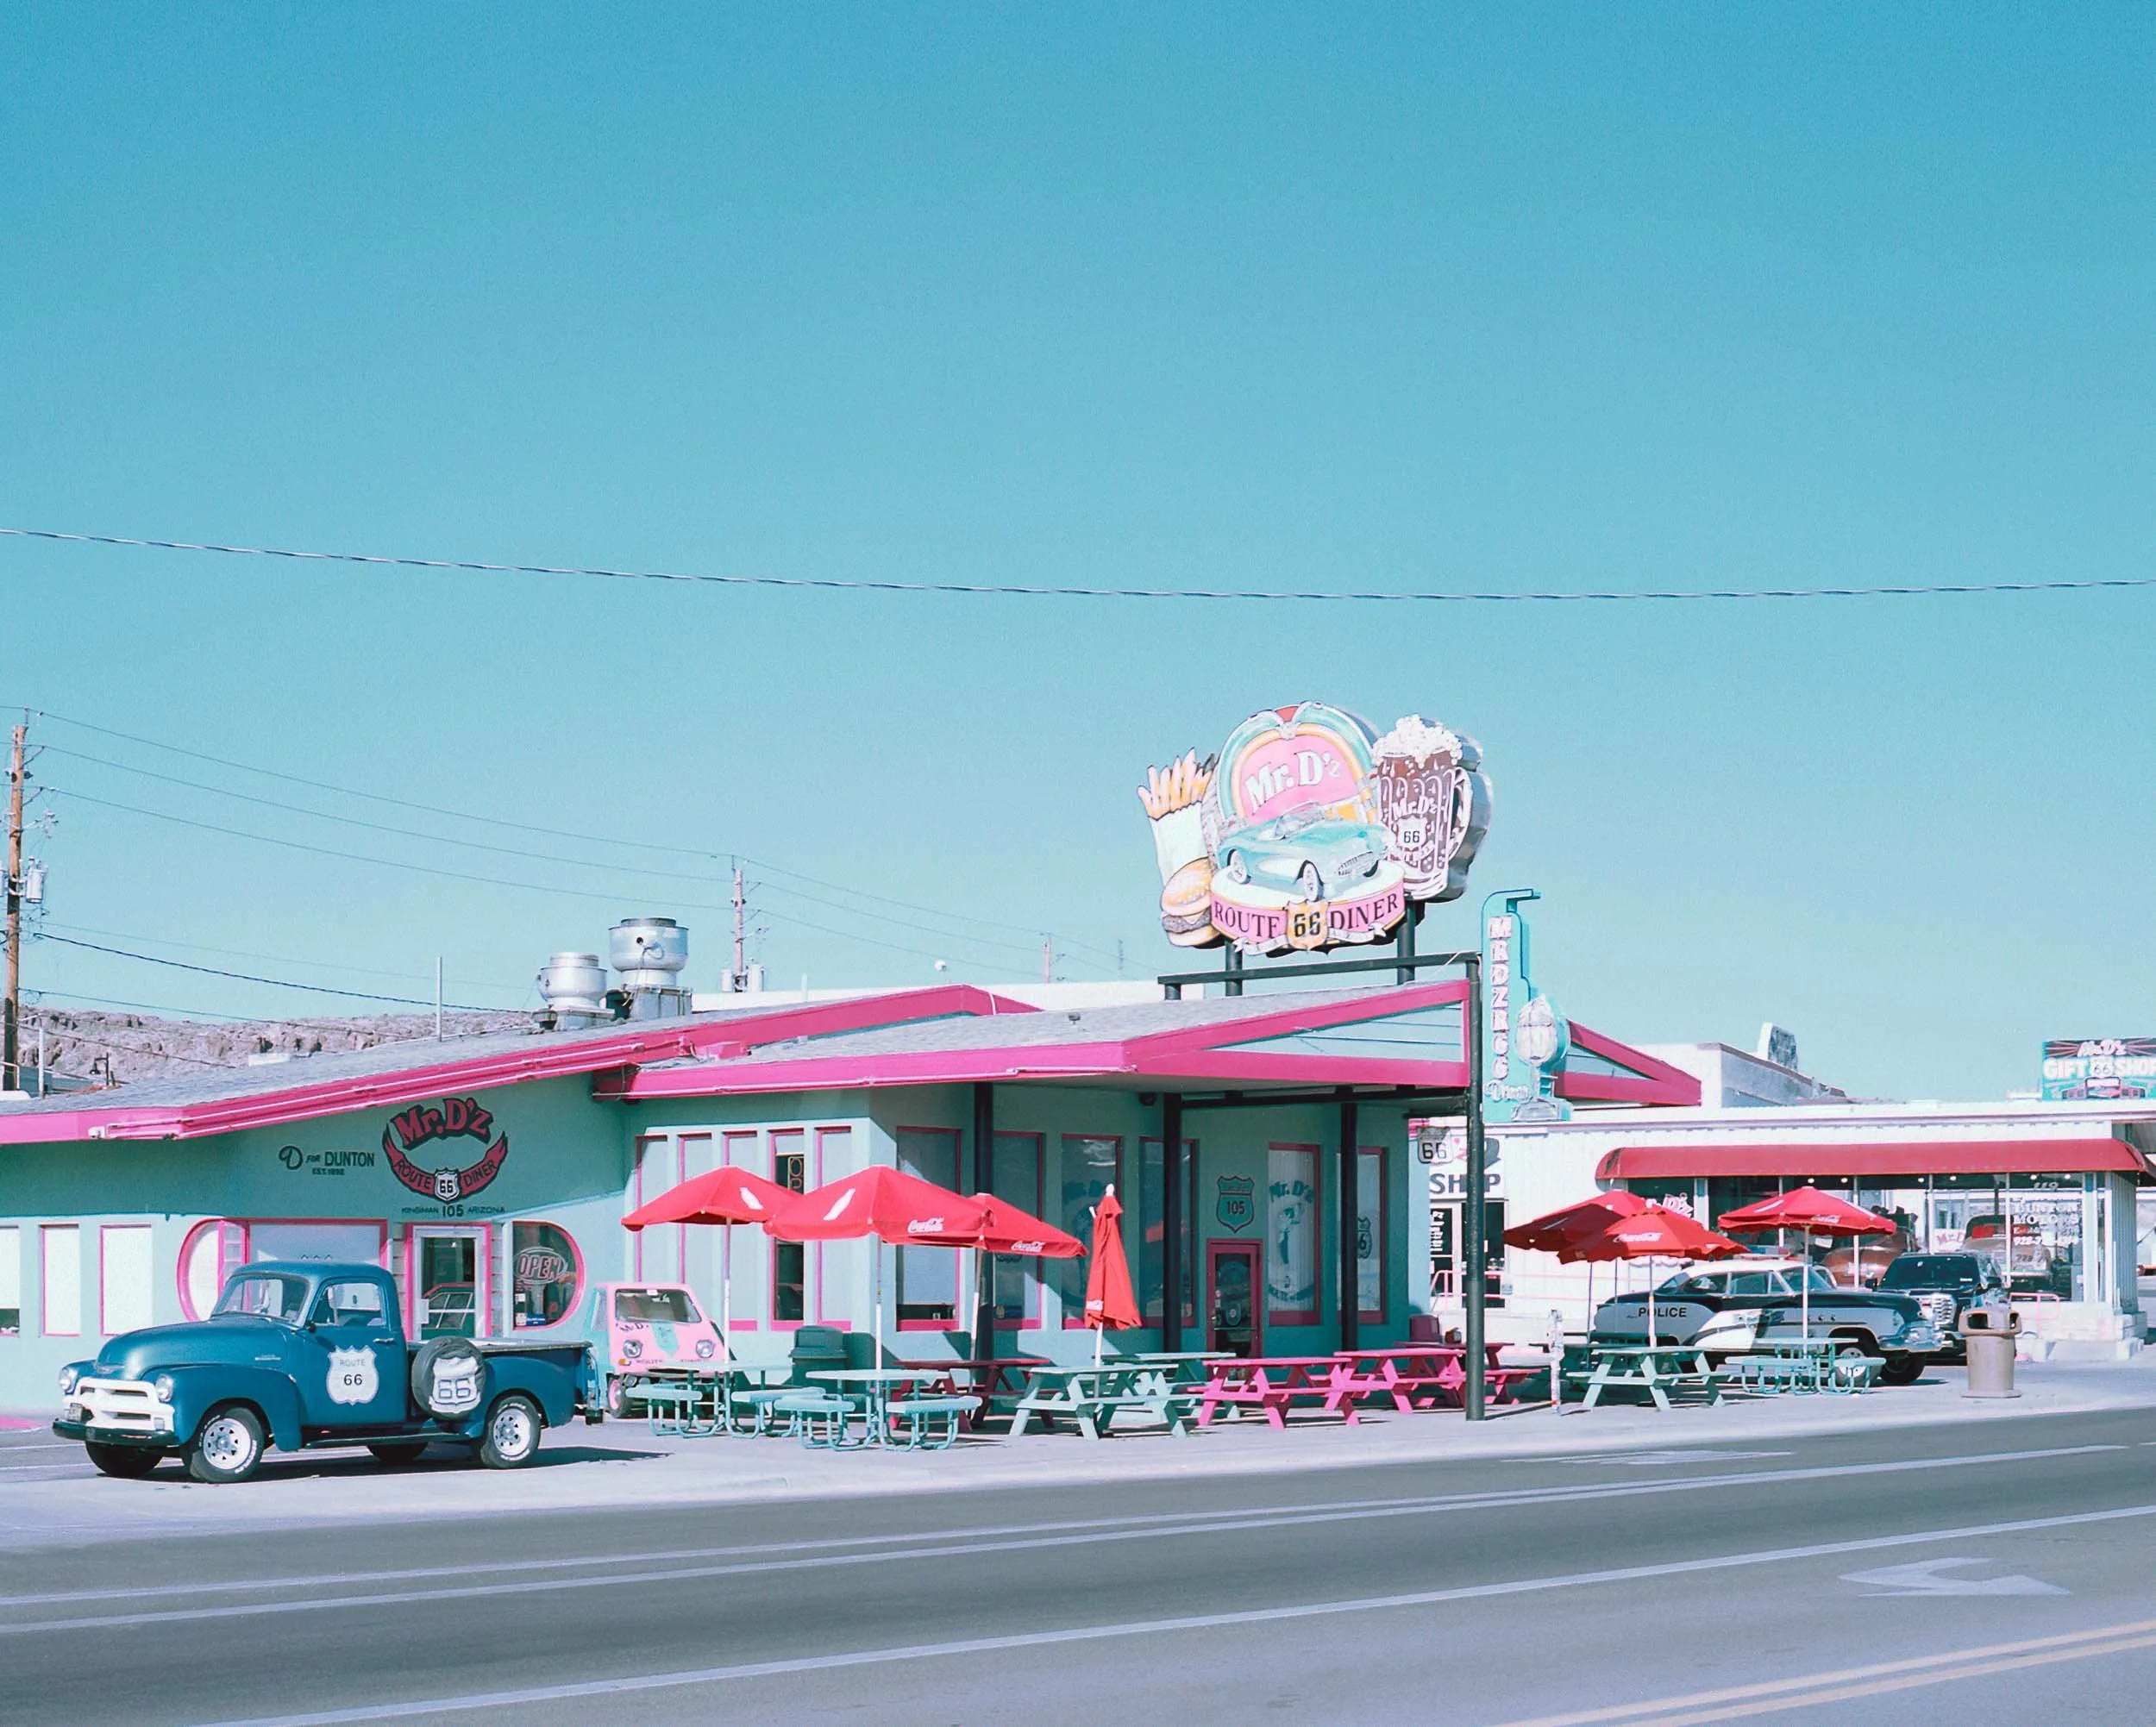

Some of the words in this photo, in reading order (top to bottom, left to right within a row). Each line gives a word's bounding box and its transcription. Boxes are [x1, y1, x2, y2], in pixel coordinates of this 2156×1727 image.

[1403, 830, 1420, 843] 66
[1214, 901, 1281, 939] ROUTE
[1294, 911, 1321, 937] 66
[1330, 893, 1399, 930] DINER
[2043, 1058, 2088, 1079] GIFT
[2094, 1064, 2111, 1074] 66
[392, 1106, 444, 1148] Mr.
[279, 1145, 304, 1170] D
[324, 1151, 375, 1167] DUNTON
[1422, 1142, 1447, 1161] 66
[394, 1159, 431, 1189] ROUTE
[439, 1179, 454, 1192] 66
[464, 1160, 497, 1187] DINER
[1429, 1173, 1501, 1194] SHP
[442, 1205, 464, 1217] 105
[1227, 1200, 1245, 1215] 105
[518, 1254, 561, 1281] OPEN
[344, 1373, 363, 1386] 66
[438, 1378, 472, 1398] 66
